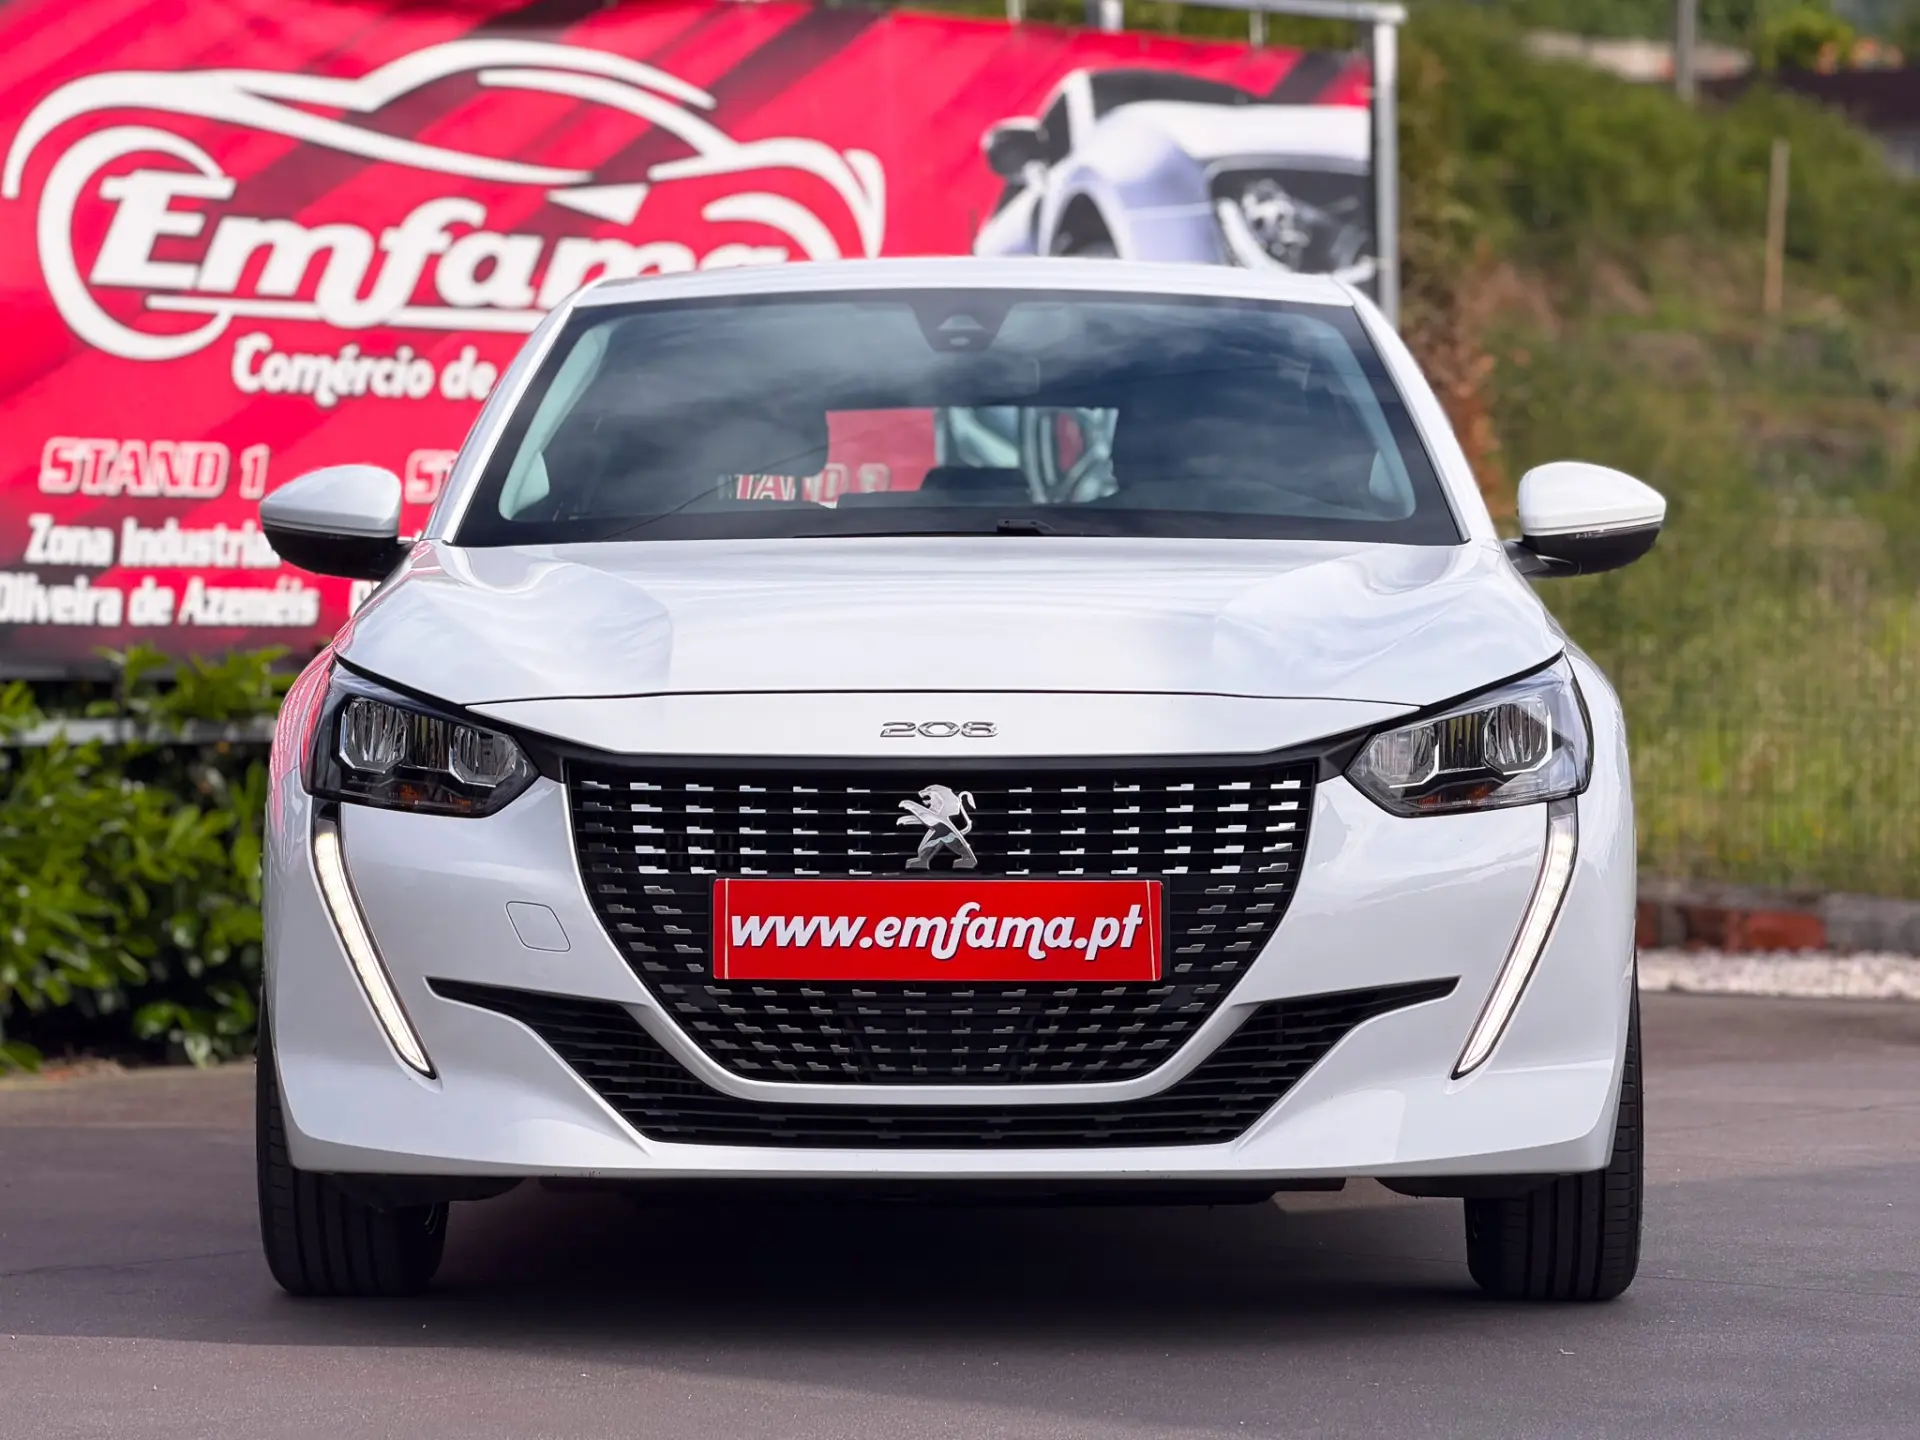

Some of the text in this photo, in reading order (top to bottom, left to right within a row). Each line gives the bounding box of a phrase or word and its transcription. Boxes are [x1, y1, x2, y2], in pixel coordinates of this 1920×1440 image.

[88, 168, 788, 328] Emfam
[231, 332, 497, 408] Comércio de
[38, 437, 271, 500] STAND 1
[24, 512, 283, 569] Zona Industria
[127, 575, 175, 626] de
[177, 575, 320, 626] Azeméis
[880, 720, 1000, 738] 208
[731, 901, 1144, 961] www.emfama.pt
